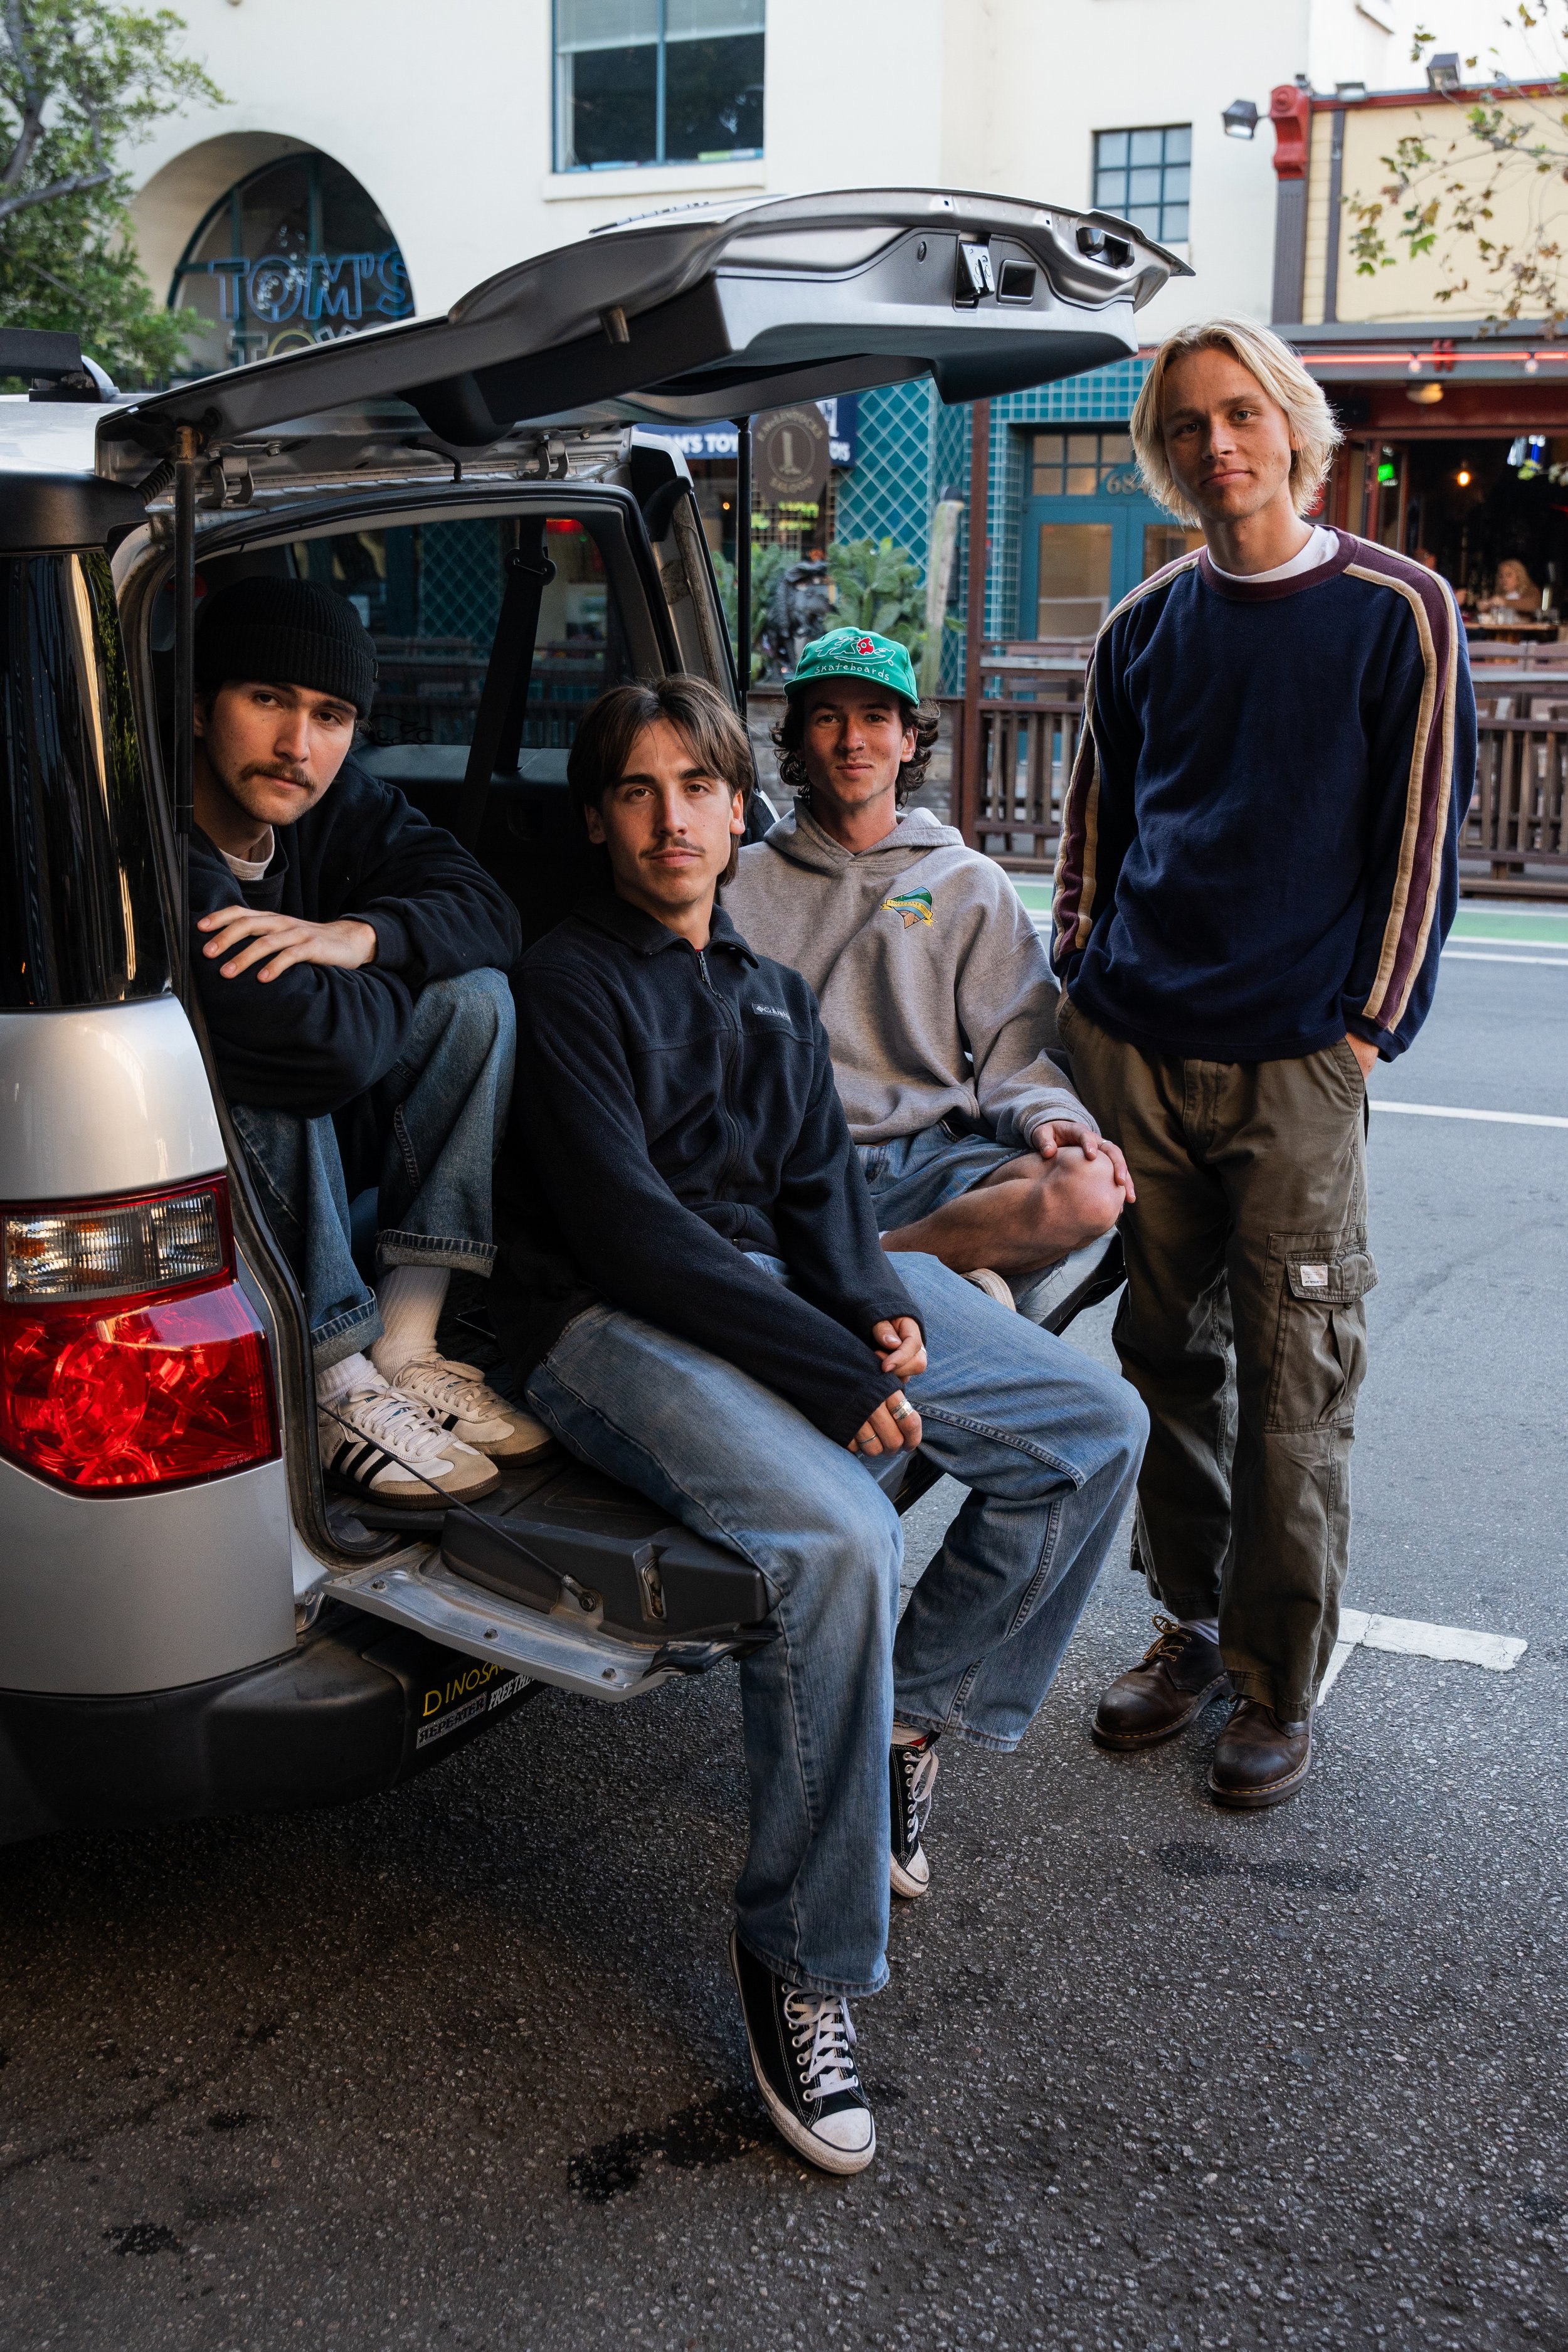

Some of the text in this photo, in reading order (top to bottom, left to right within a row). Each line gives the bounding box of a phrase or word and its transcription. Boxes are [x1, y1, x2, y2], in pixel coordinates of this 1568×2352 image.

[208, 250, 415, 322] TOM'S
[331, 1438, 342, 1453] SAMBA
[423, 1661, 505, 1717] DINOSA
[488, 1678, 514, 1711] FREE
